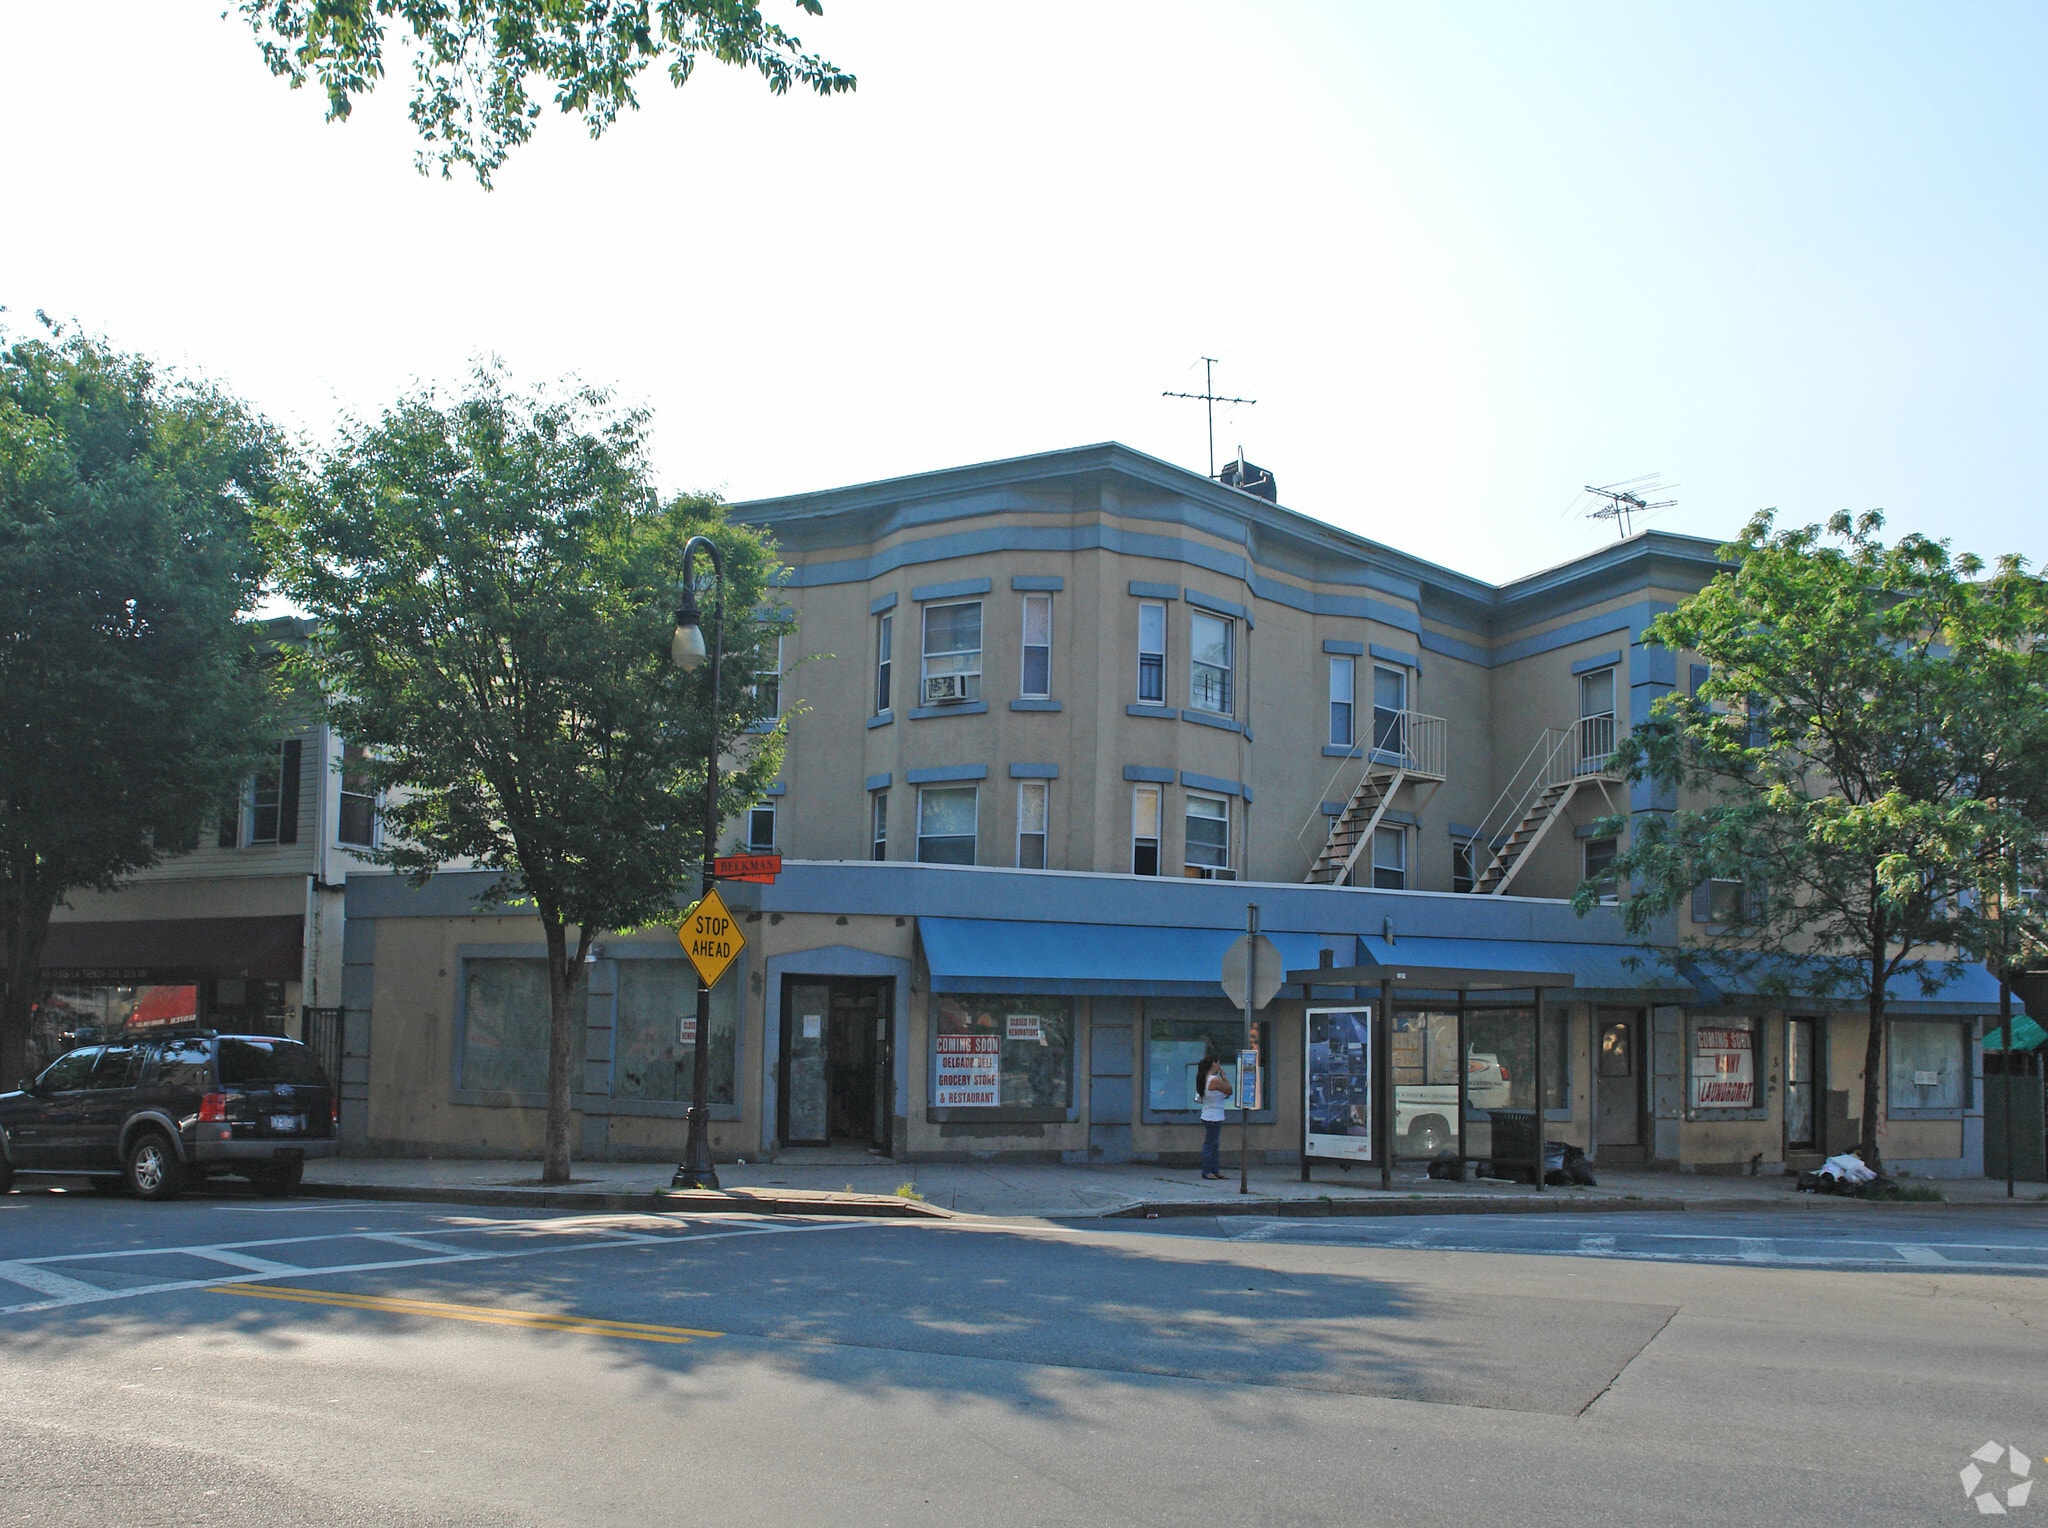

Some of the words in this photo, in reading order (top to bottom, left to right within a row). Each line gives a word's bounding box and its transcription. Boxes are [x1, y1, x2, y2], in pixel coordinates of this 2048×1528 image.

[721, 859, 774, 872] BEEKMAN
[695, 916, 729, 936] STOP
[692, 940, 730, 958] AHEAD
[1010, 1018, 1027, 1026] CLOSED
[1028, 1018, 1037, 1026] FOR
[1008, 1028, 1039, 1036] RENOVATIONS
[937, 1038, 971, 1051] COMING
[975, 1038, 998, 1051] SOON
[1698, 1031, 1729, 1048] COMING
[1731, 1032, 1751, 1048] SOON
[942, 1057, 974, 1068] DELGADO
[938, 1074, 971, 1086] GROCERY
[973, 1074, 996, 1086] STORE
[940, 1093, 945, 1103] &
[948, 1092, 994, 1104] RESTAURANT
[1700, 1082, 1753, 1102] LAUNDROMAT
